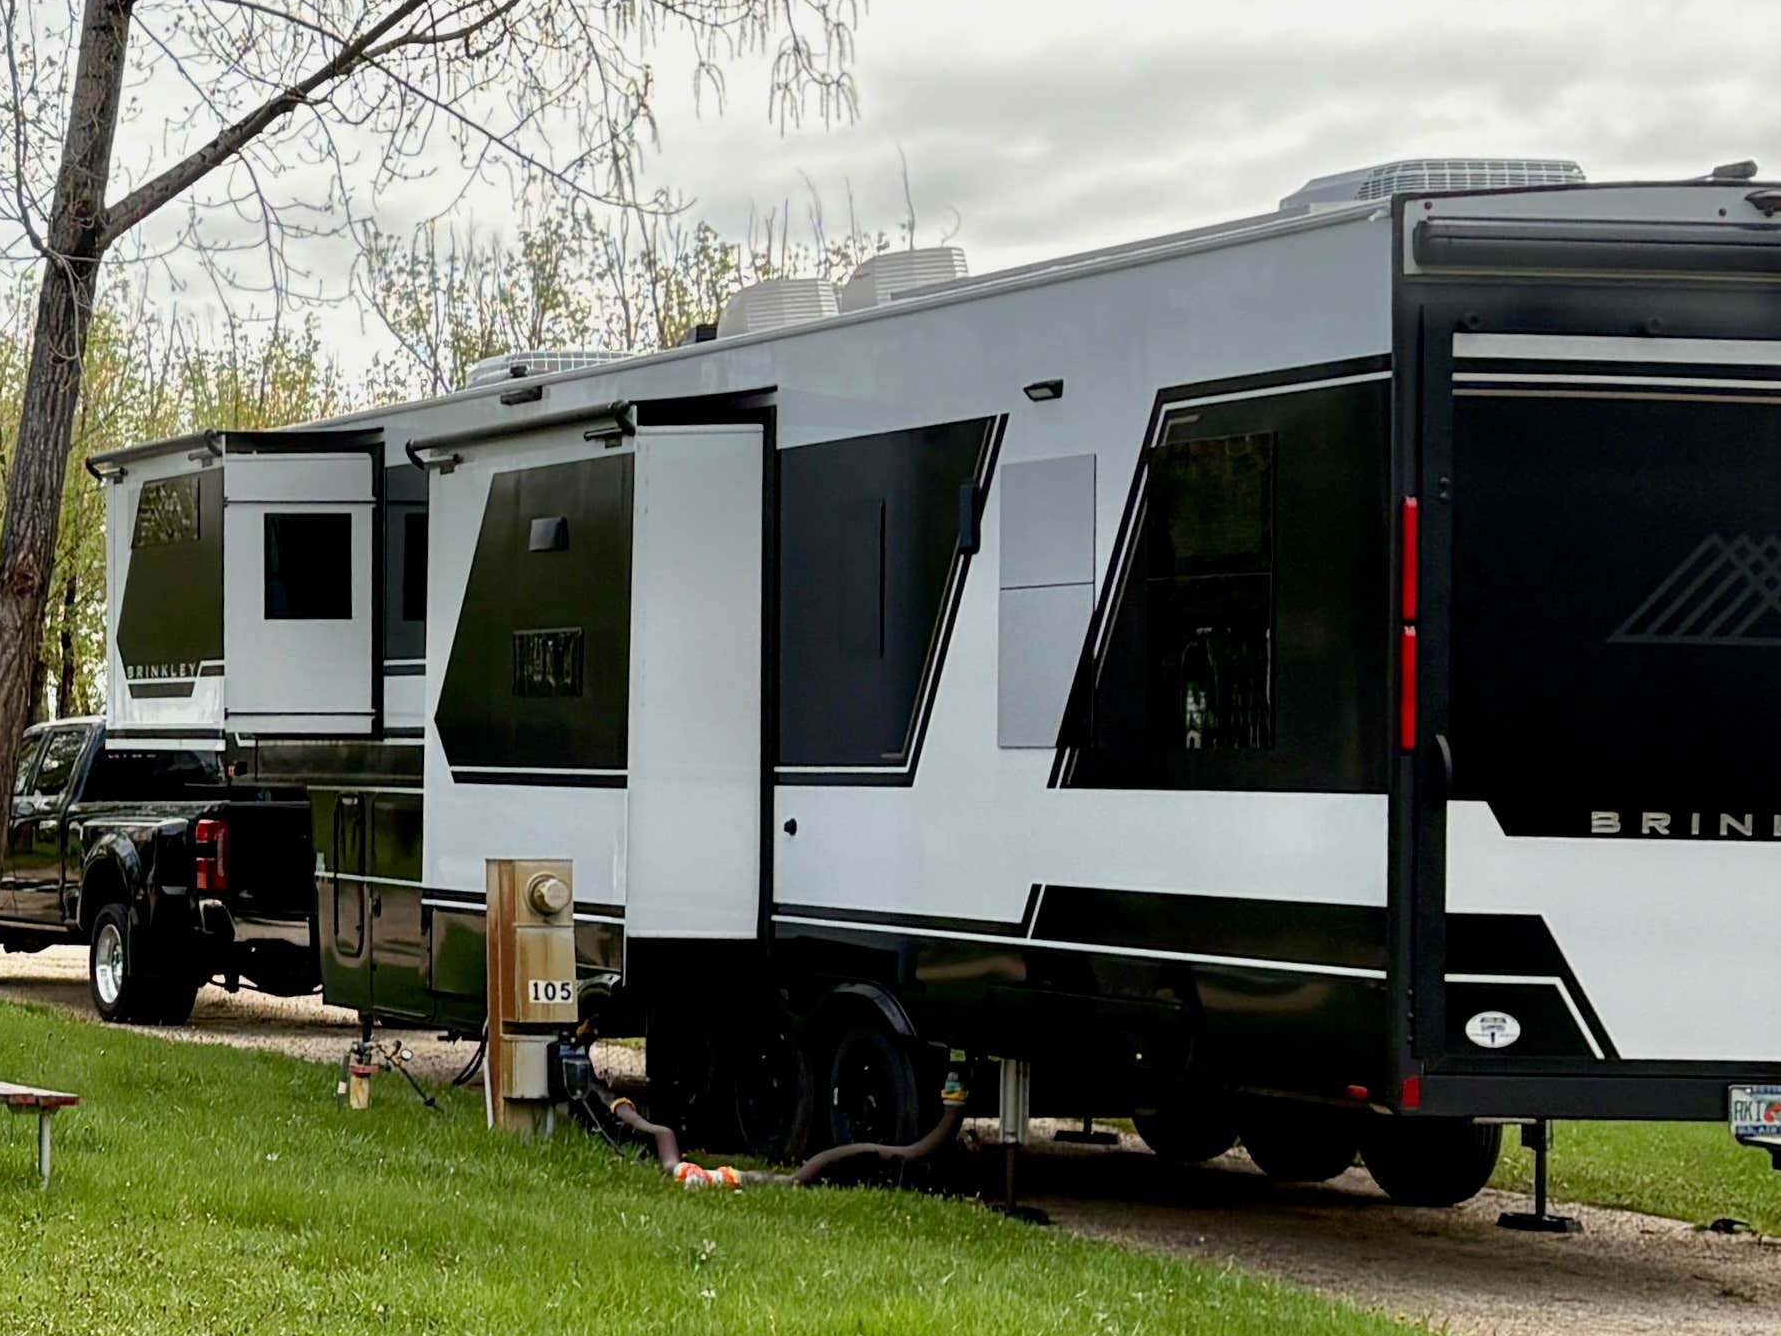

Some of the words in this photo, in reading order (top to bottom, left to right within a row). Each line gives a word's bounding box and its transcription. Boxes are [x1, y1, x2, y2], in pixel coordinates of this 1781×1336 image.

[126, 662, 197, 679] BRINKLEY
[1590, 810, 1781, 837] BRIN
[533, 982, 571, 1001] 105
